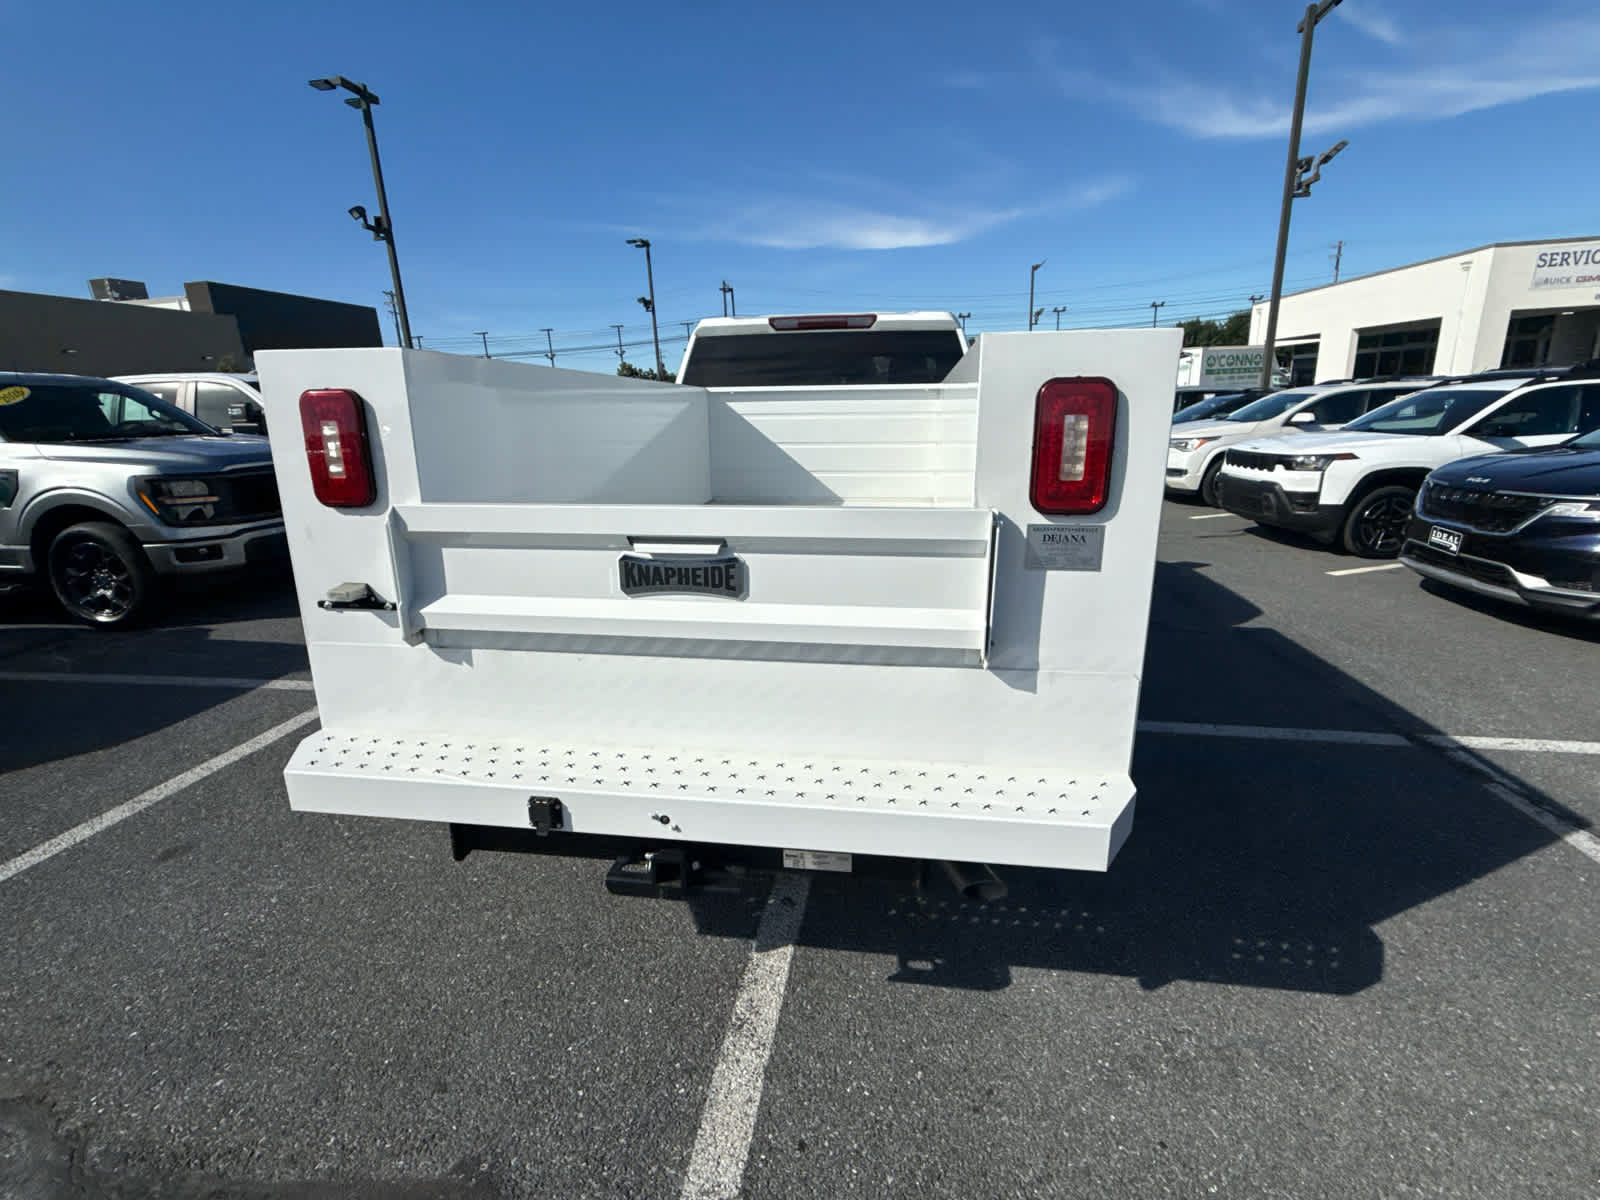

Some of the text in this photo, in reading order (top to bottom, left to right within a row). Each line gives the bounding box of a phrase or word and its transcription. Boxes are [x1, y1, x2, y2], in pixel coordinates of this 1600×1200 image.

[1536, 249, 1600, 268] SERVIC
[1207, 352, 1264, 367] O'CONNO
[1042, 533, 1088, 545] DEJANA
[1432, 530, 1459, 544] IDEAL
[624, 560, 737, 592] KNAPHEIDE
